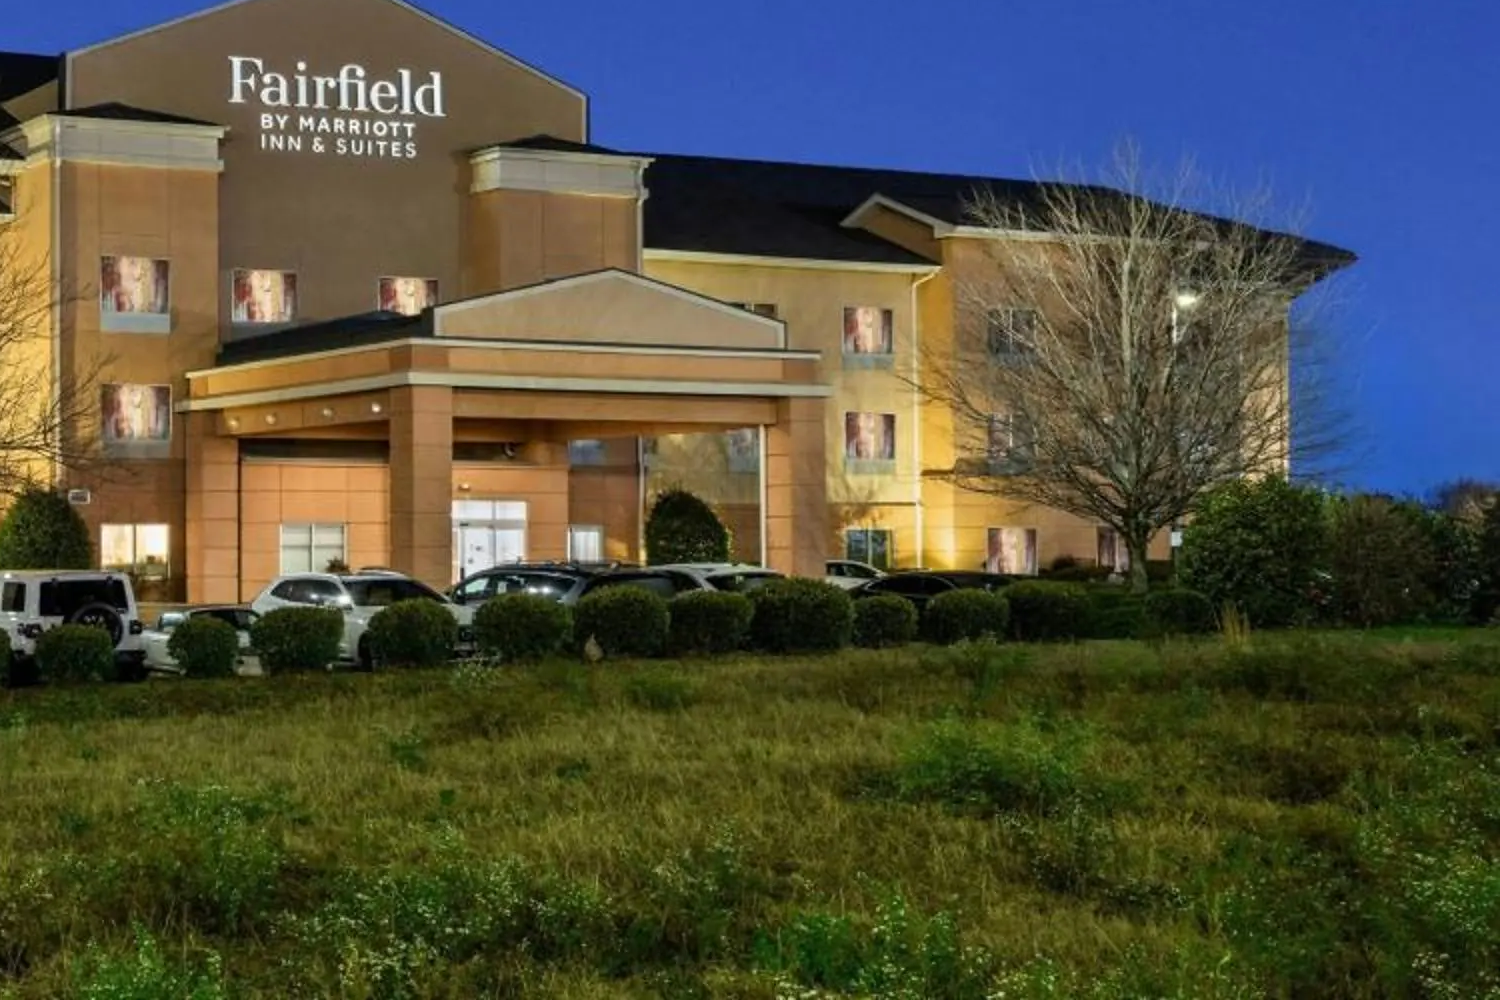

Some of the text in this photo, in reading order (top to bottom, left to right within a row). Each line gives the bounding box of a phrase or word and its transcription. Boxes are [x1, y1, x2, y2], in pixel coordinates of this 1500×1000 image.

[228, 55, 446, 117] Fairfield
[261, 113, 416, 138] BY MARRIOTT
[261, 134, 417, 159] INN & SUITES
